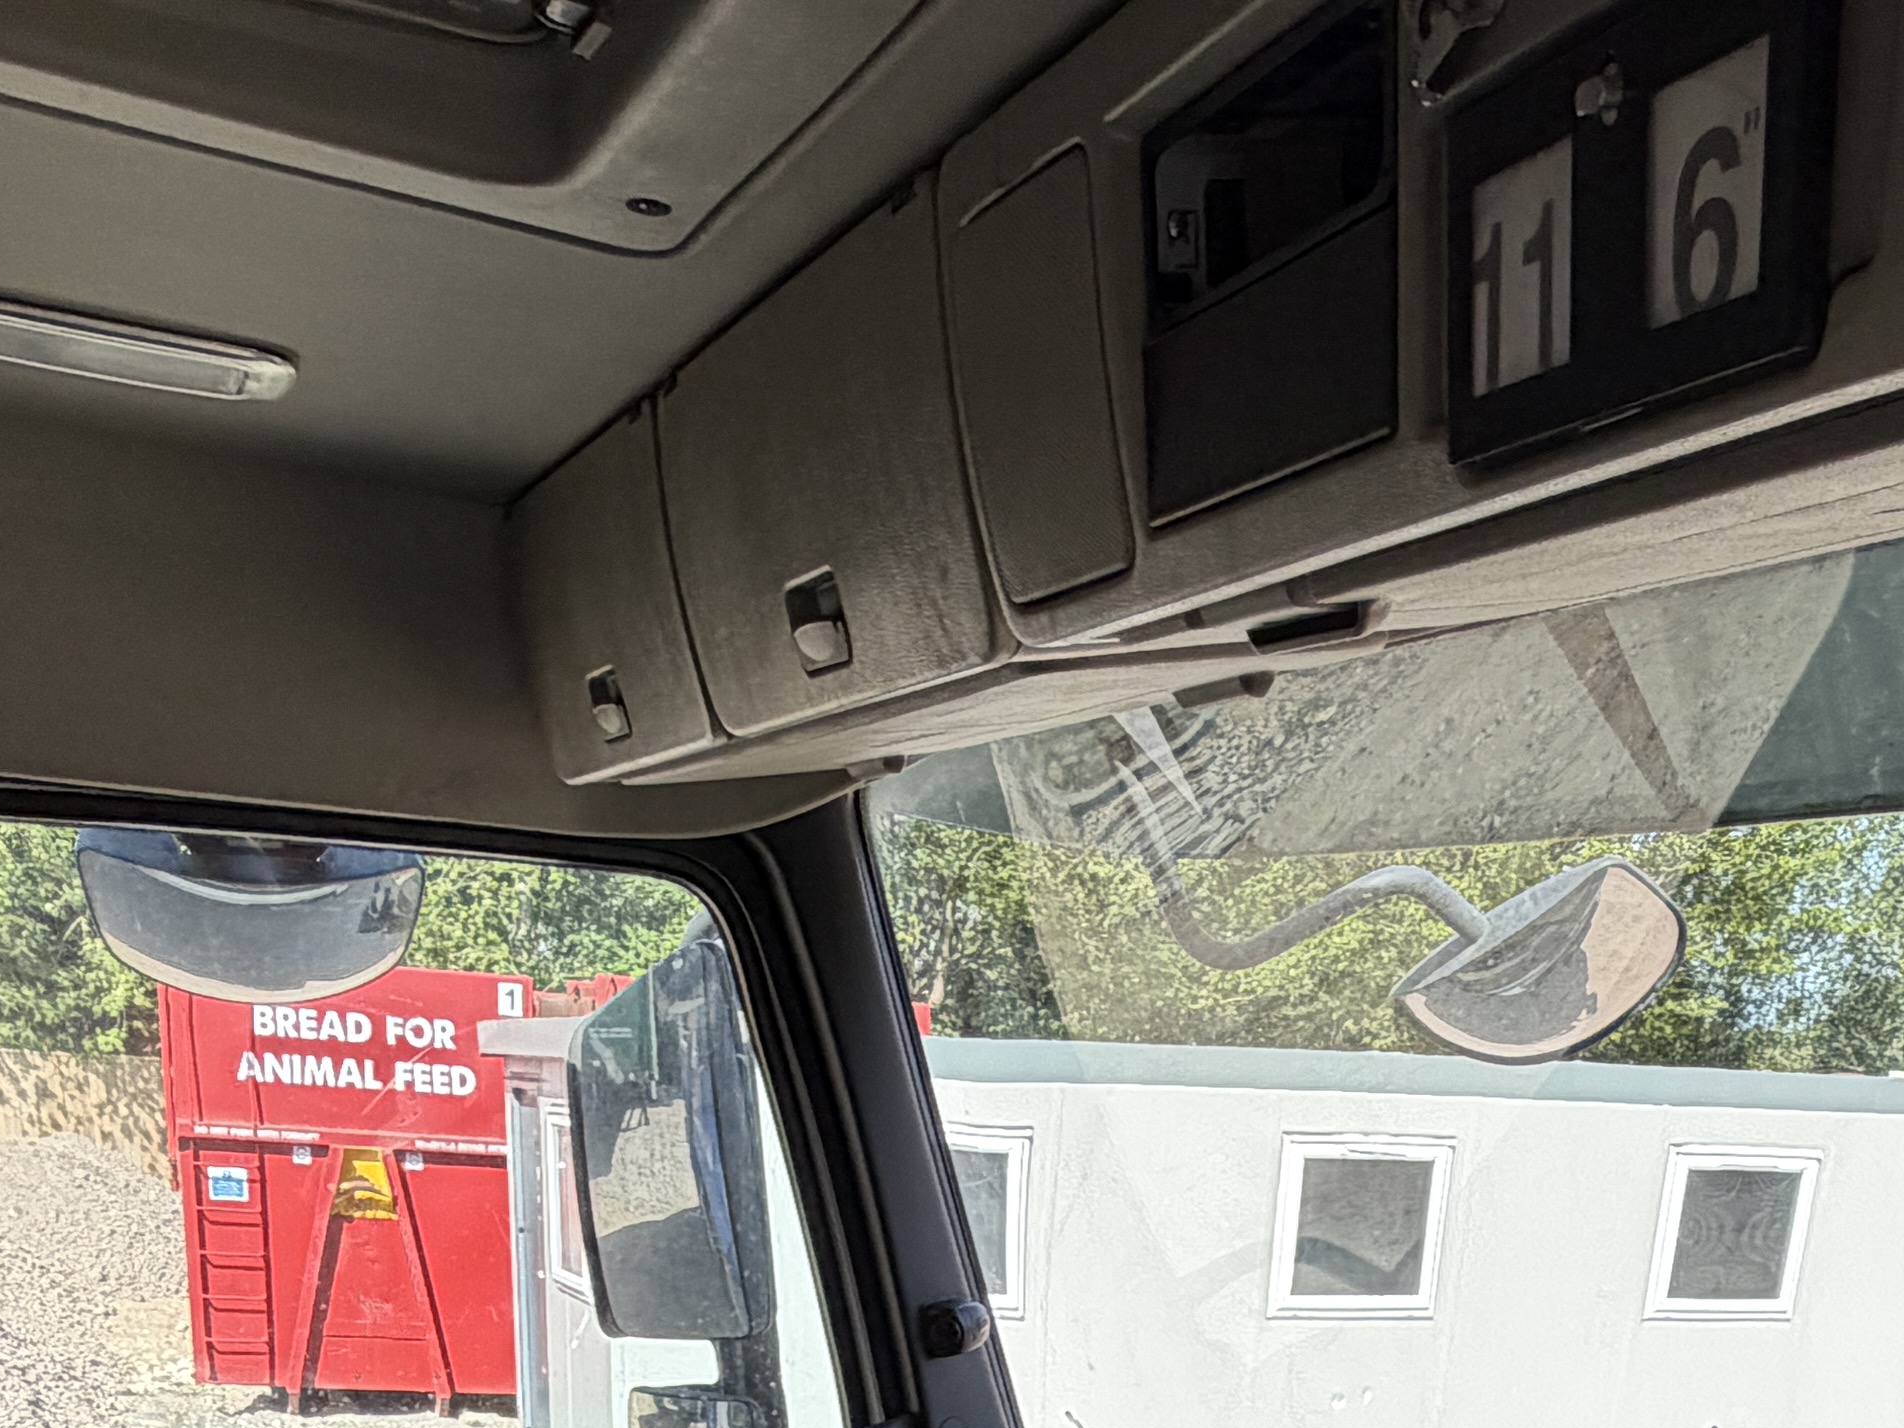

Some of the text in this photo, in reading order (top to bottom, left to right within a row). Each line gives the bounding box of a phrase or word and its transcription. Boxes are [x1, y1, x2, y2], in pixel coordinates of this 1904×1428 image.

[252, 1004, 458, 1050] BREAD FOR
[236, 1051, 478, 1097] ANIMAL FEED
